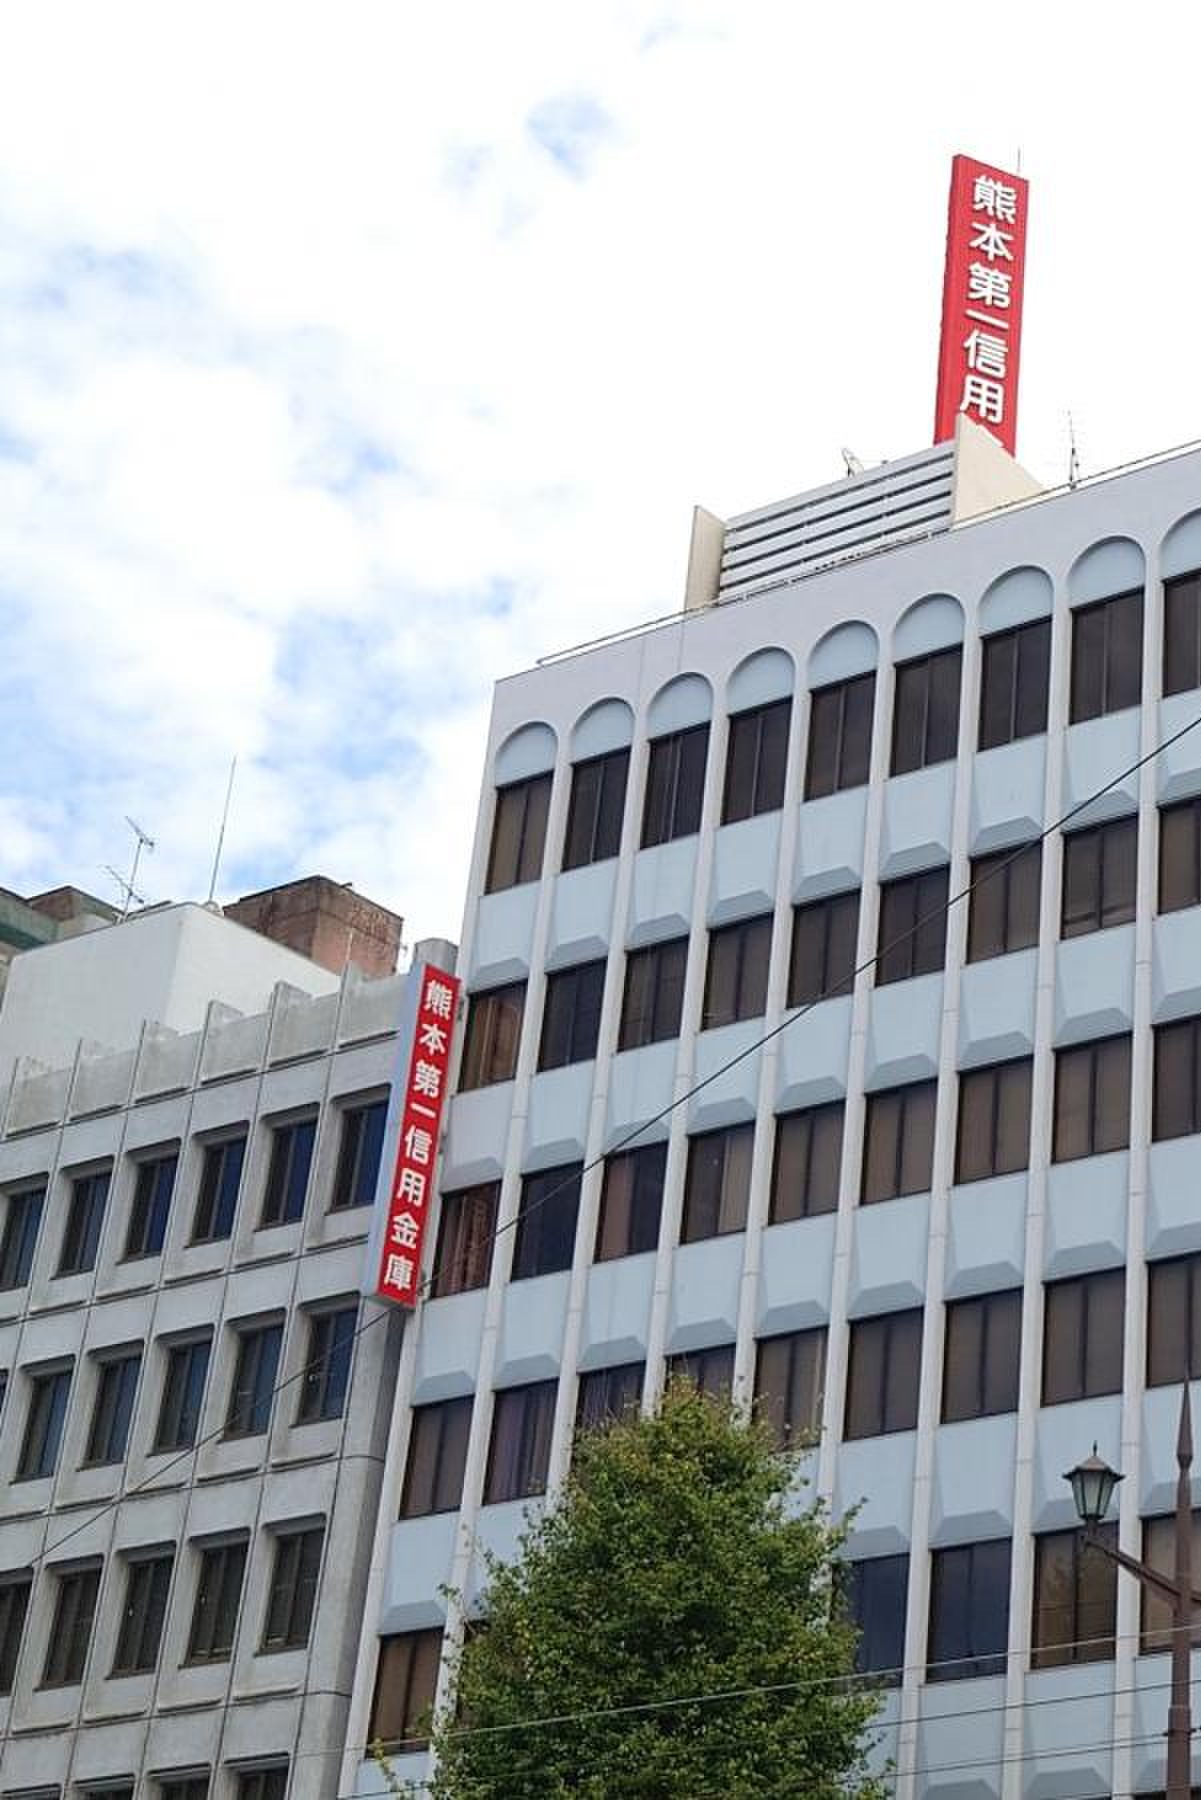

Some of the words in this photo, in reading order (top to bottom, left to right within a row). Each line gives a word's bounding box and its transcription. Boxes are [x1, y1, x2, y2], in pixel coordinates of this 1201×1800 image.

[959, 175, 1017, 424] 熊本第一信用
[384, 980, 452, 1290] 熊本第一信用金庫
